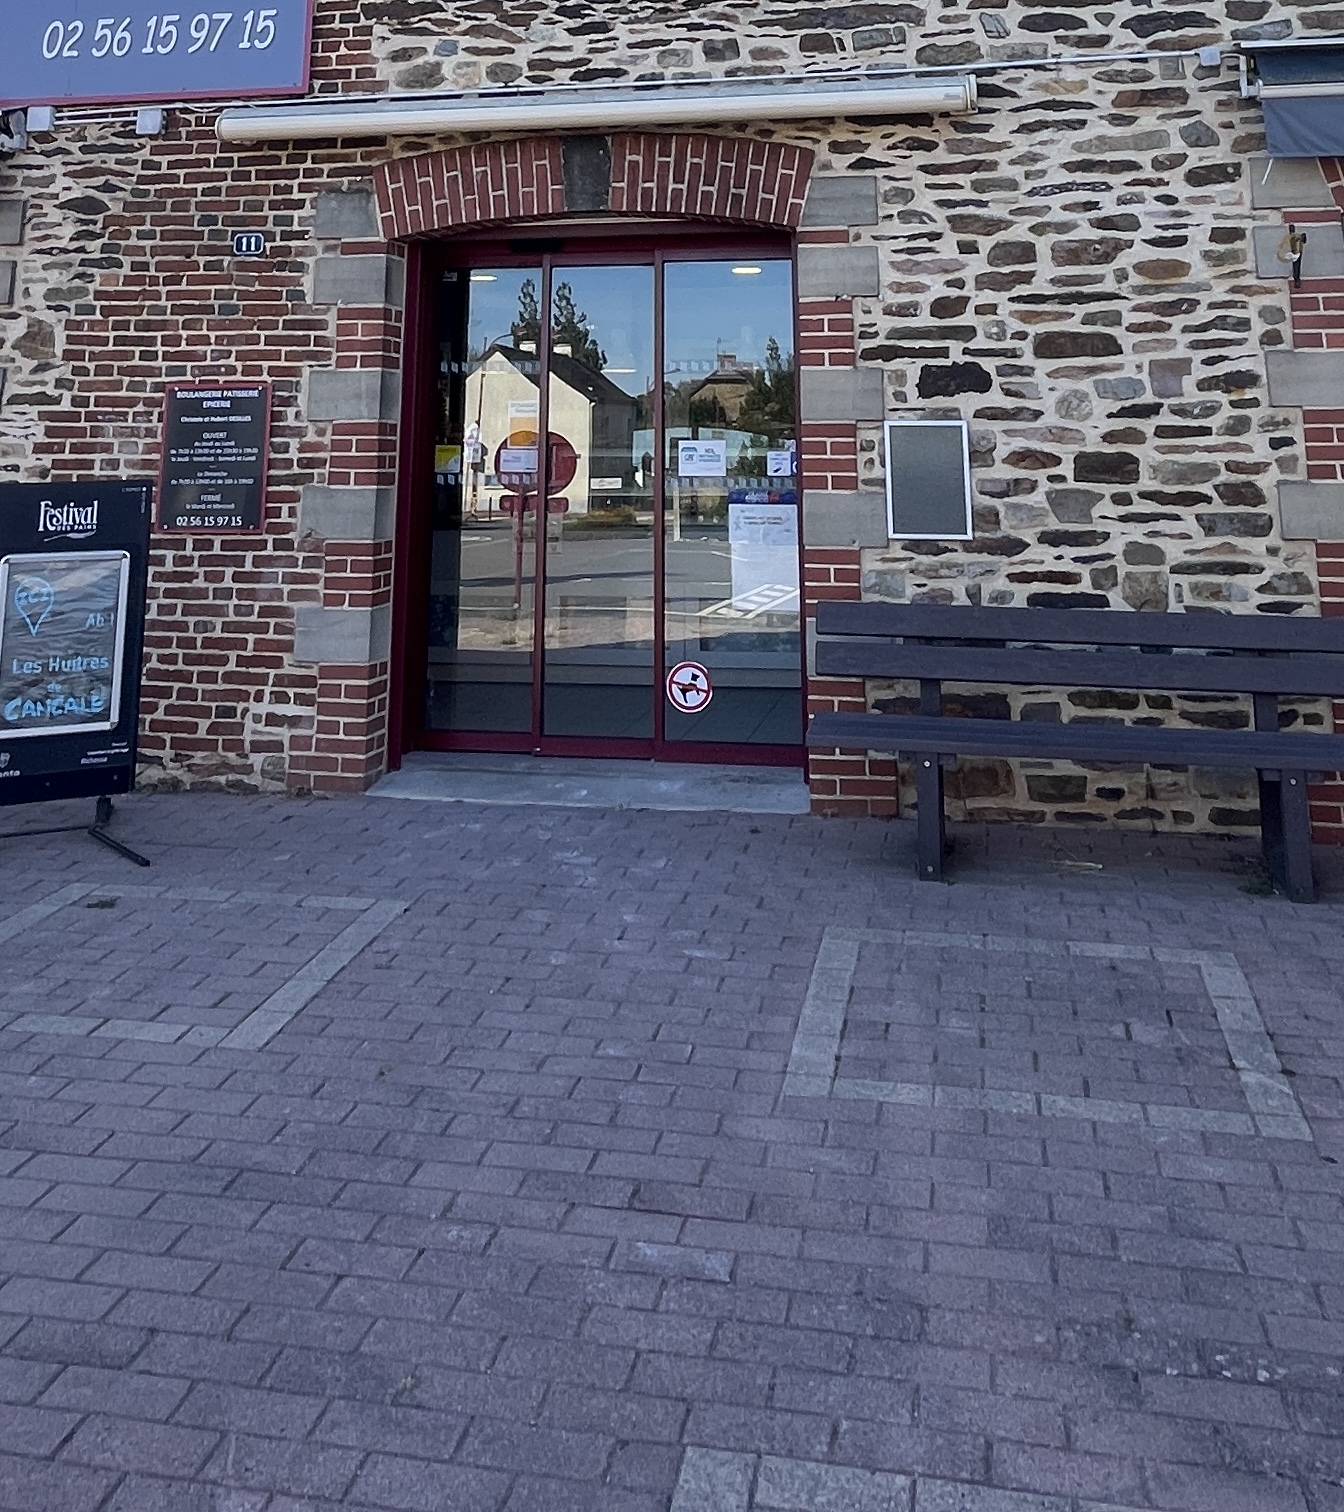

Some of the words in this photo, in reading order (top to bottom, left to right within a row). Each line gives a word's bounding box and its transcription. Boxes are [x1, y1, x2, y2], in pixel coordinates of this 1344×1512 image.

[42, 20, 84, 59] 02
[91, 17, 132, 57] 56
[141, 14, 180, 55] 15
[187, 12, 233, 54] 97
[238, 8, 278, 50] 15
[241, 236, 256, 251] 11
[37, 500, 99, 532] Festival
[176, 516, 188, 526] 02
[189, 516, 202, 526] 56
[204, 516, 215, 526] 15
[216, 516, 229, 526] 97
[231, 516, 242, 526] 15
[12, 658, 42, 675] Les
